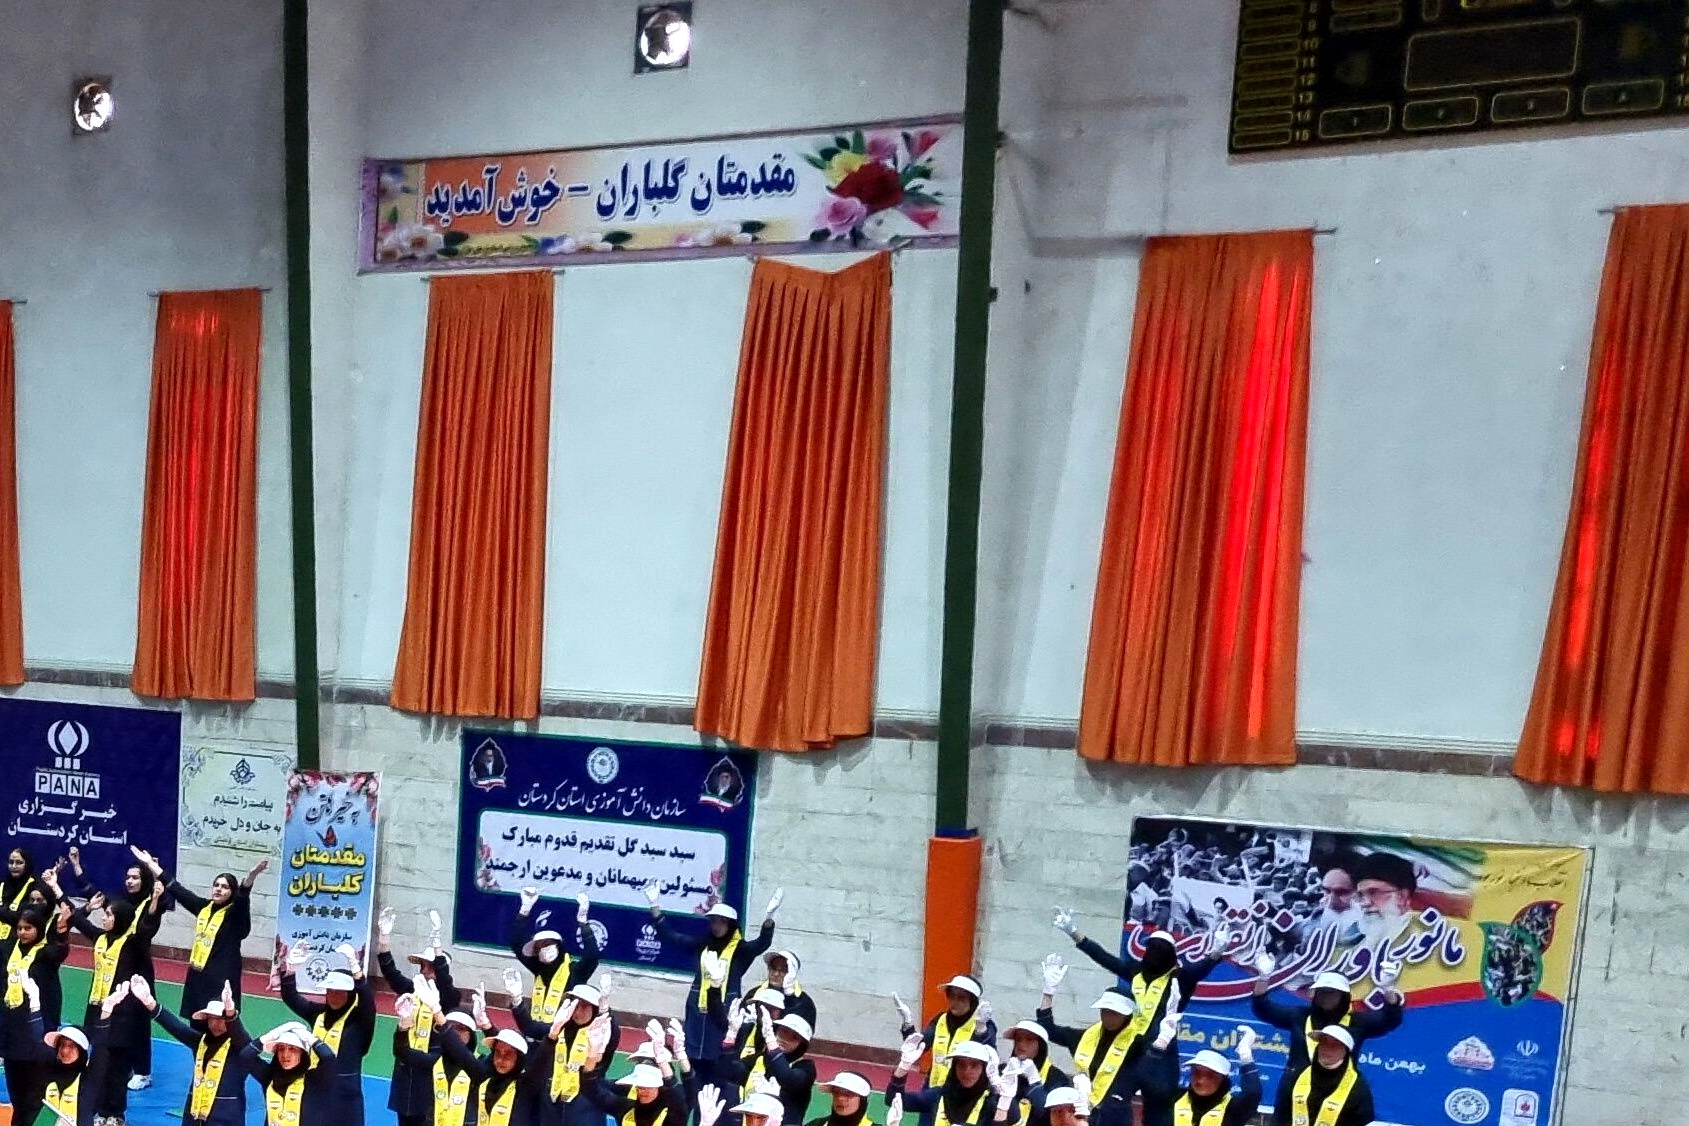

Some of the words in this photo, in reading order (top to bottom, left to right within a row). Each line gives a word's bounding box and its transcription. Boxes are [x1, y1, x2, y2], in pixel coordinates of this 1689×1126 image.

[596, 158, 687, 218] گلباران
[691, 153, 796, 213] مقدمتان
[426, 166, 500, 225] آمدید
[497, 167, 560, 224] خوش
[38, 774, 98, 797] PANA
[518, 779, 568, 810] کردستان
[556, 786, 585, 811] استان
[585, 787, 627, 813] آموزی
[623, 787, 651, 816] دانش
[651, 798, 687, 819] سازمان
[7, 817, 78, 843] کردستان
[79, 826, 128, 845] استان
[502, 826, 542, 848] مبارک
[545, 830, 577, 850] قدوم
[580, 835, 615, 852] تقدیم
[617, 837, 638, 857] گل
[640, 843, 666, 858] سبد
[669, 846, 695, 863] سبد
[291, 842, 366, 869] مقدمتان
[486, 859, 531, 879] ارجمند
[532, 863, 582, 882] مدعوین
[586, 872, 593, 886] و
[660, 875, 713, 897] مسئولین
[1391, 907, 1466, 965] مانور
[1358, 1051, 1382, 1066] ماه
[1384, 1058, 1426, 1075] بهمن
